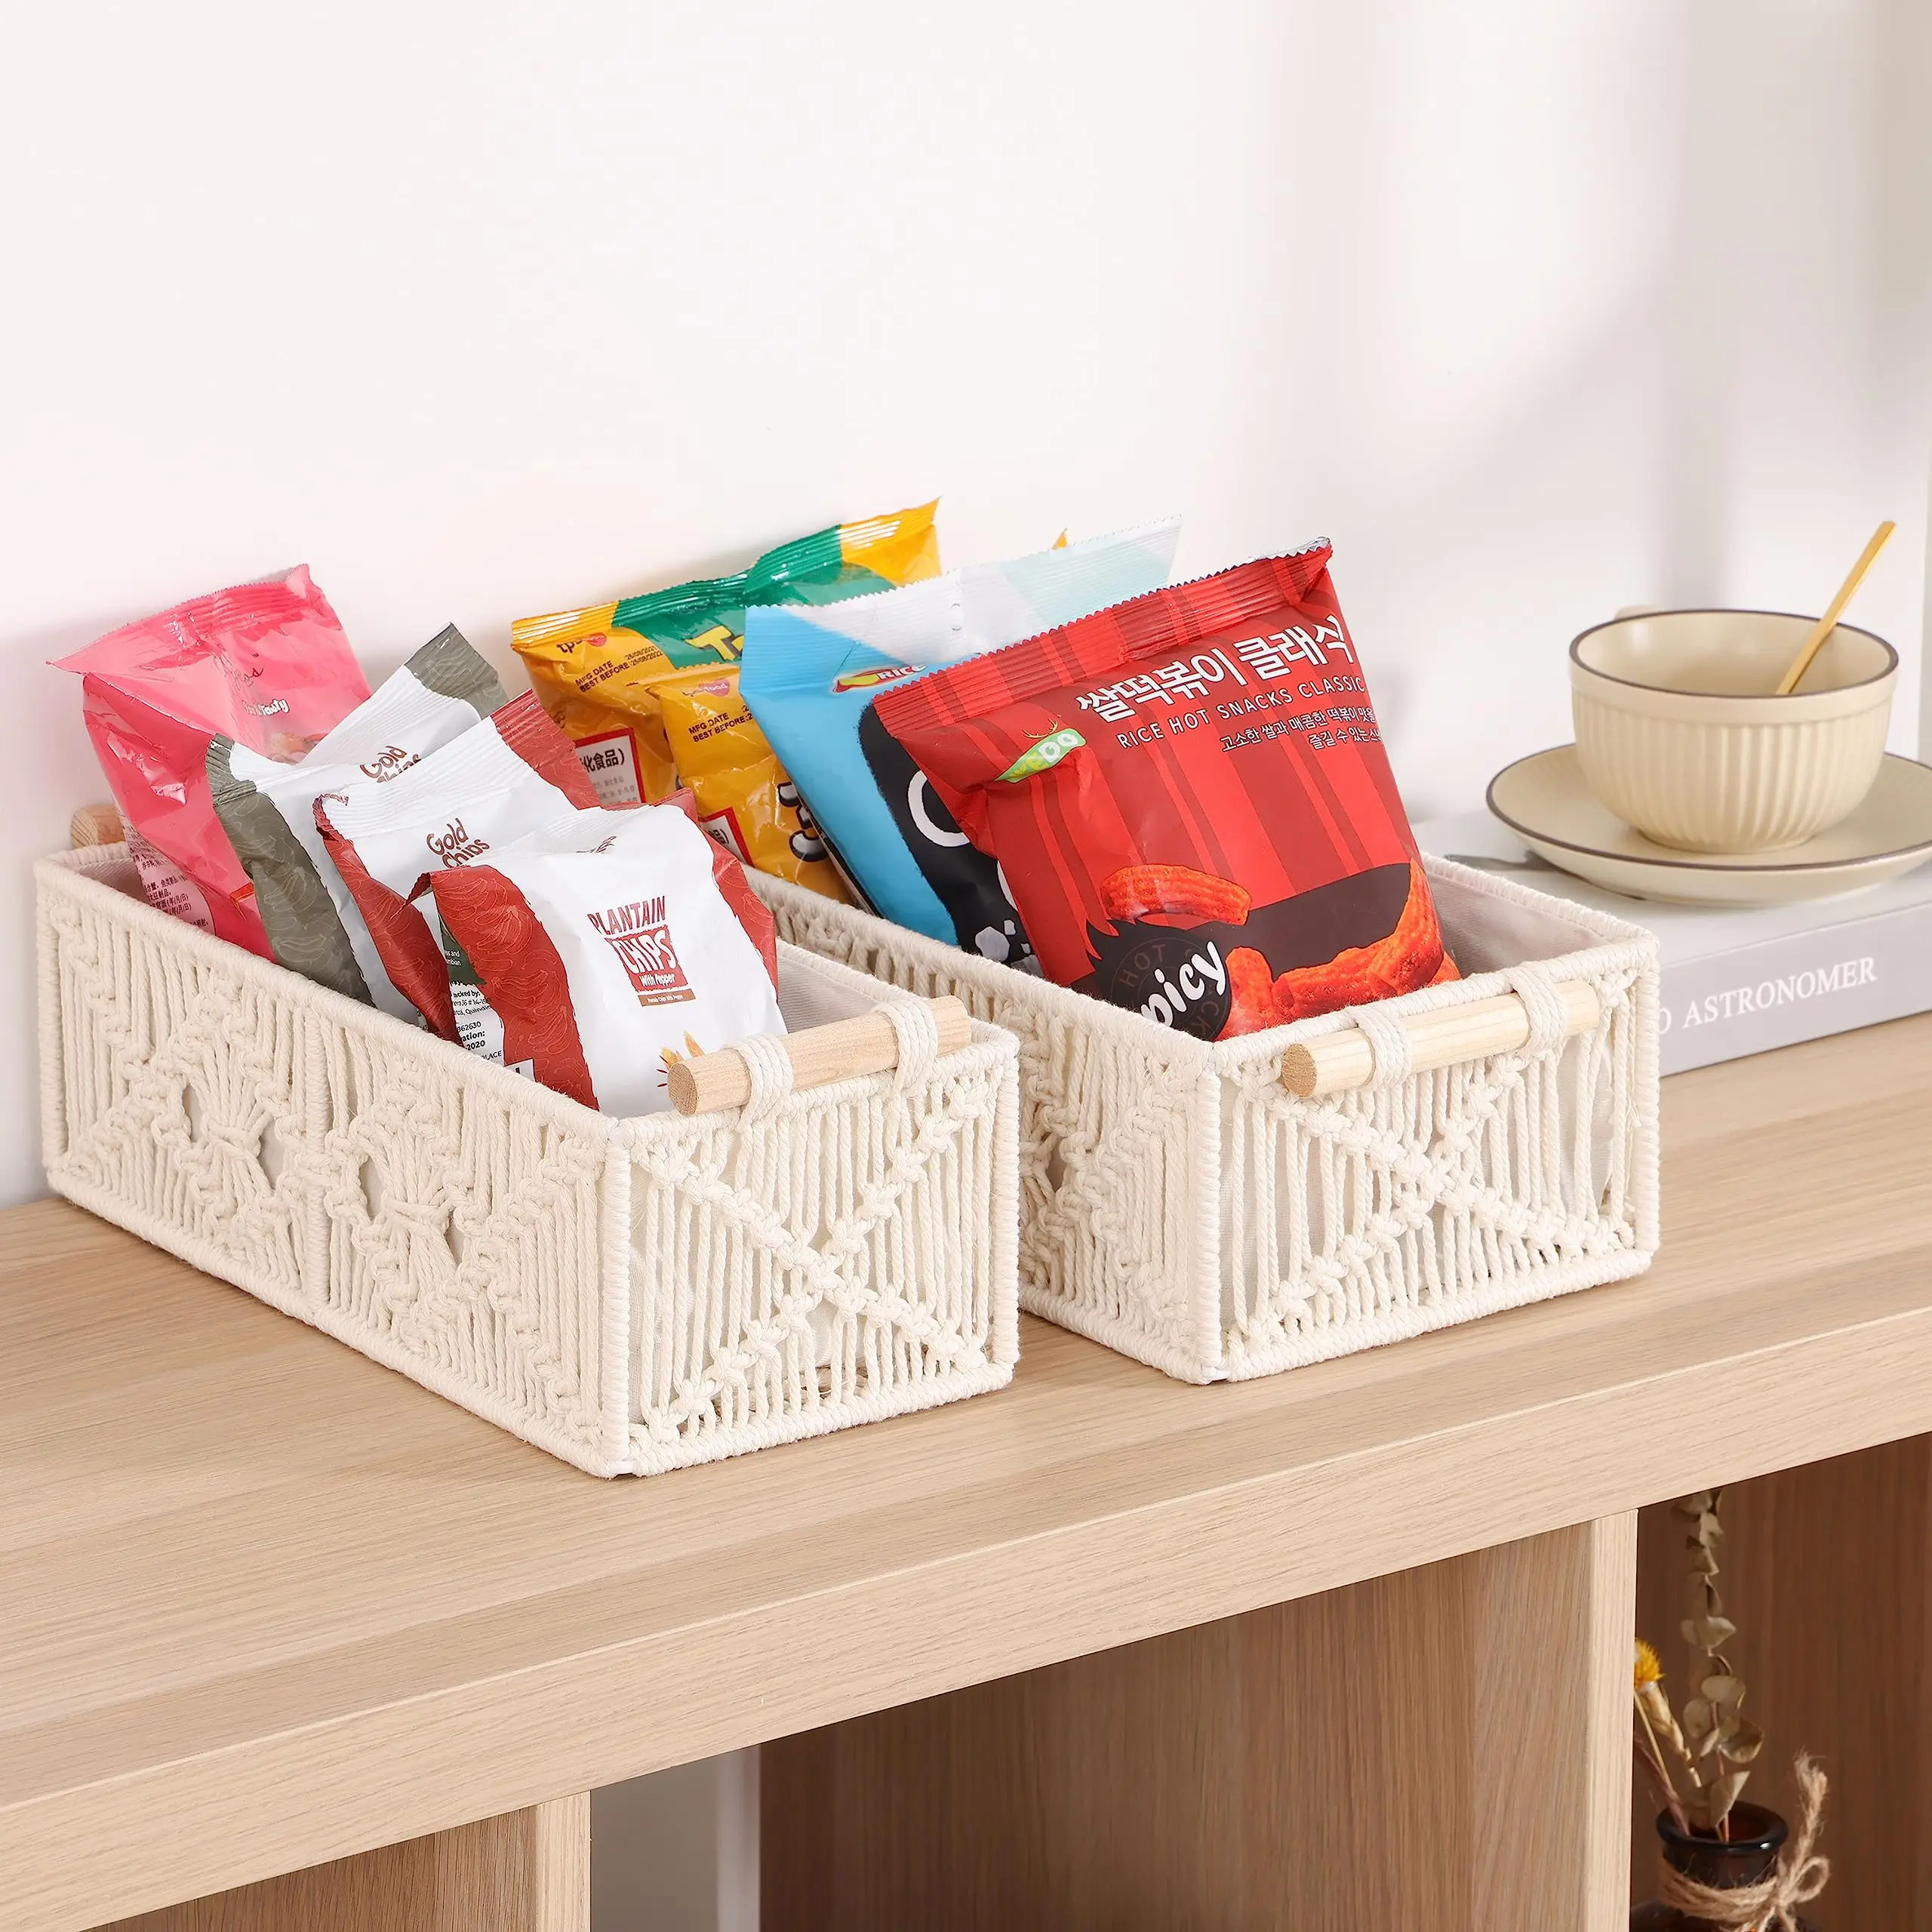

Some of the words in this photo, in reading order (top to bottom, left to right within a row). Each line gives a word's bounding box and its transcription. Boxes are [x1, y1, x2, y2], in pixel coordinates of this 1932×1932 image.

[574, 672, 593, 687] MFG
[592, 660, 614, 675] DATE
[579, 678, 599, 693] BEST
[1075, 647, 1247, 724] 쌀떡볶이
[1232, 614, 1355, 679] 클래식
[688, 723, 708, 735] MFG
[707, 712, 730, 727] DATE
[1115, 721, 1168, 749] RICE
[1170, 708, 1209, 735] HOT
[1216, 689, 1294, 720] SNACKS
[1297, 676, 1366, 699] CLASSIC
[1220, 728, 1263, 752] 고소한
[1261, 721, 1290, 740] 쌀과
[1287, 710, 1329, 732] 매콤한
[1326, 706, 1361, 723] 떡볶이
[692, 729, 713, 743] BEST
[1308, 730, 1337, 751] 즐길
[1336, 728, 1349, 743] 수
[1348, 727, 1370, 743] 있는
[359, 745, 408, 779] Gold
[580, 748, 625, 773] 化食品)
[426, 817, 469, 855] Gold
[587, 895, 666, 936] PLANTAIN
[612, 929, 677, 974] CHIPS
[1119, 943, 1168, 987] HOT
[639, 973, 656, 987] With
[1682, 956, 1878, 1029] ASTRONOMER
